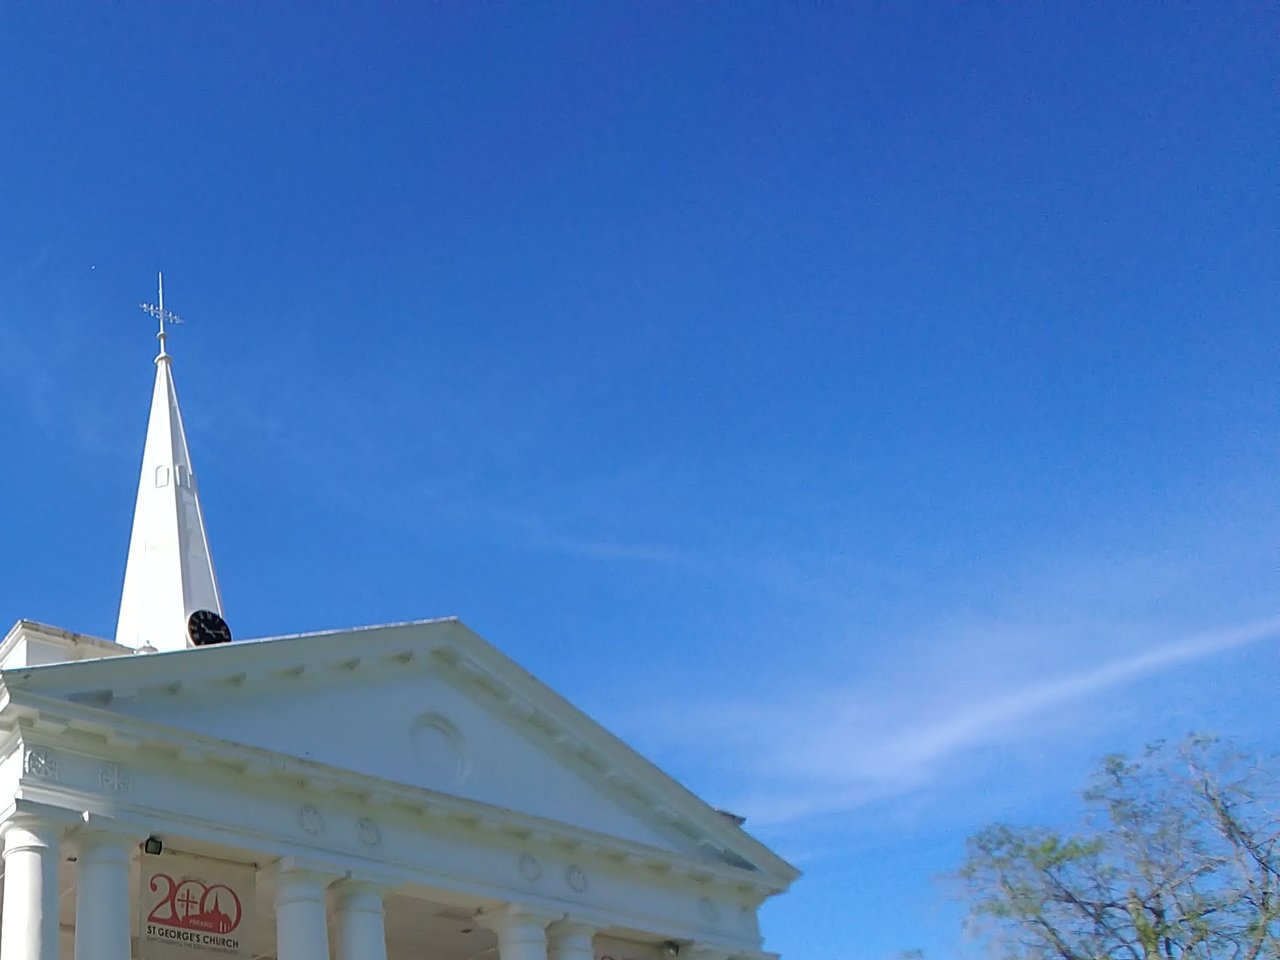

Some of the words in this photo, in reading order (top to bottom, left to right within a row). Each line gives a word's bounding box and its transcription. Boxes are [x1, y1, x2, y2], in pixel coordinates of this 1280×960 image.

[147, 873, 242, 935] 200
[147, 925, 156, 935] ST
[202, 935, 239, 949] CHURCH
